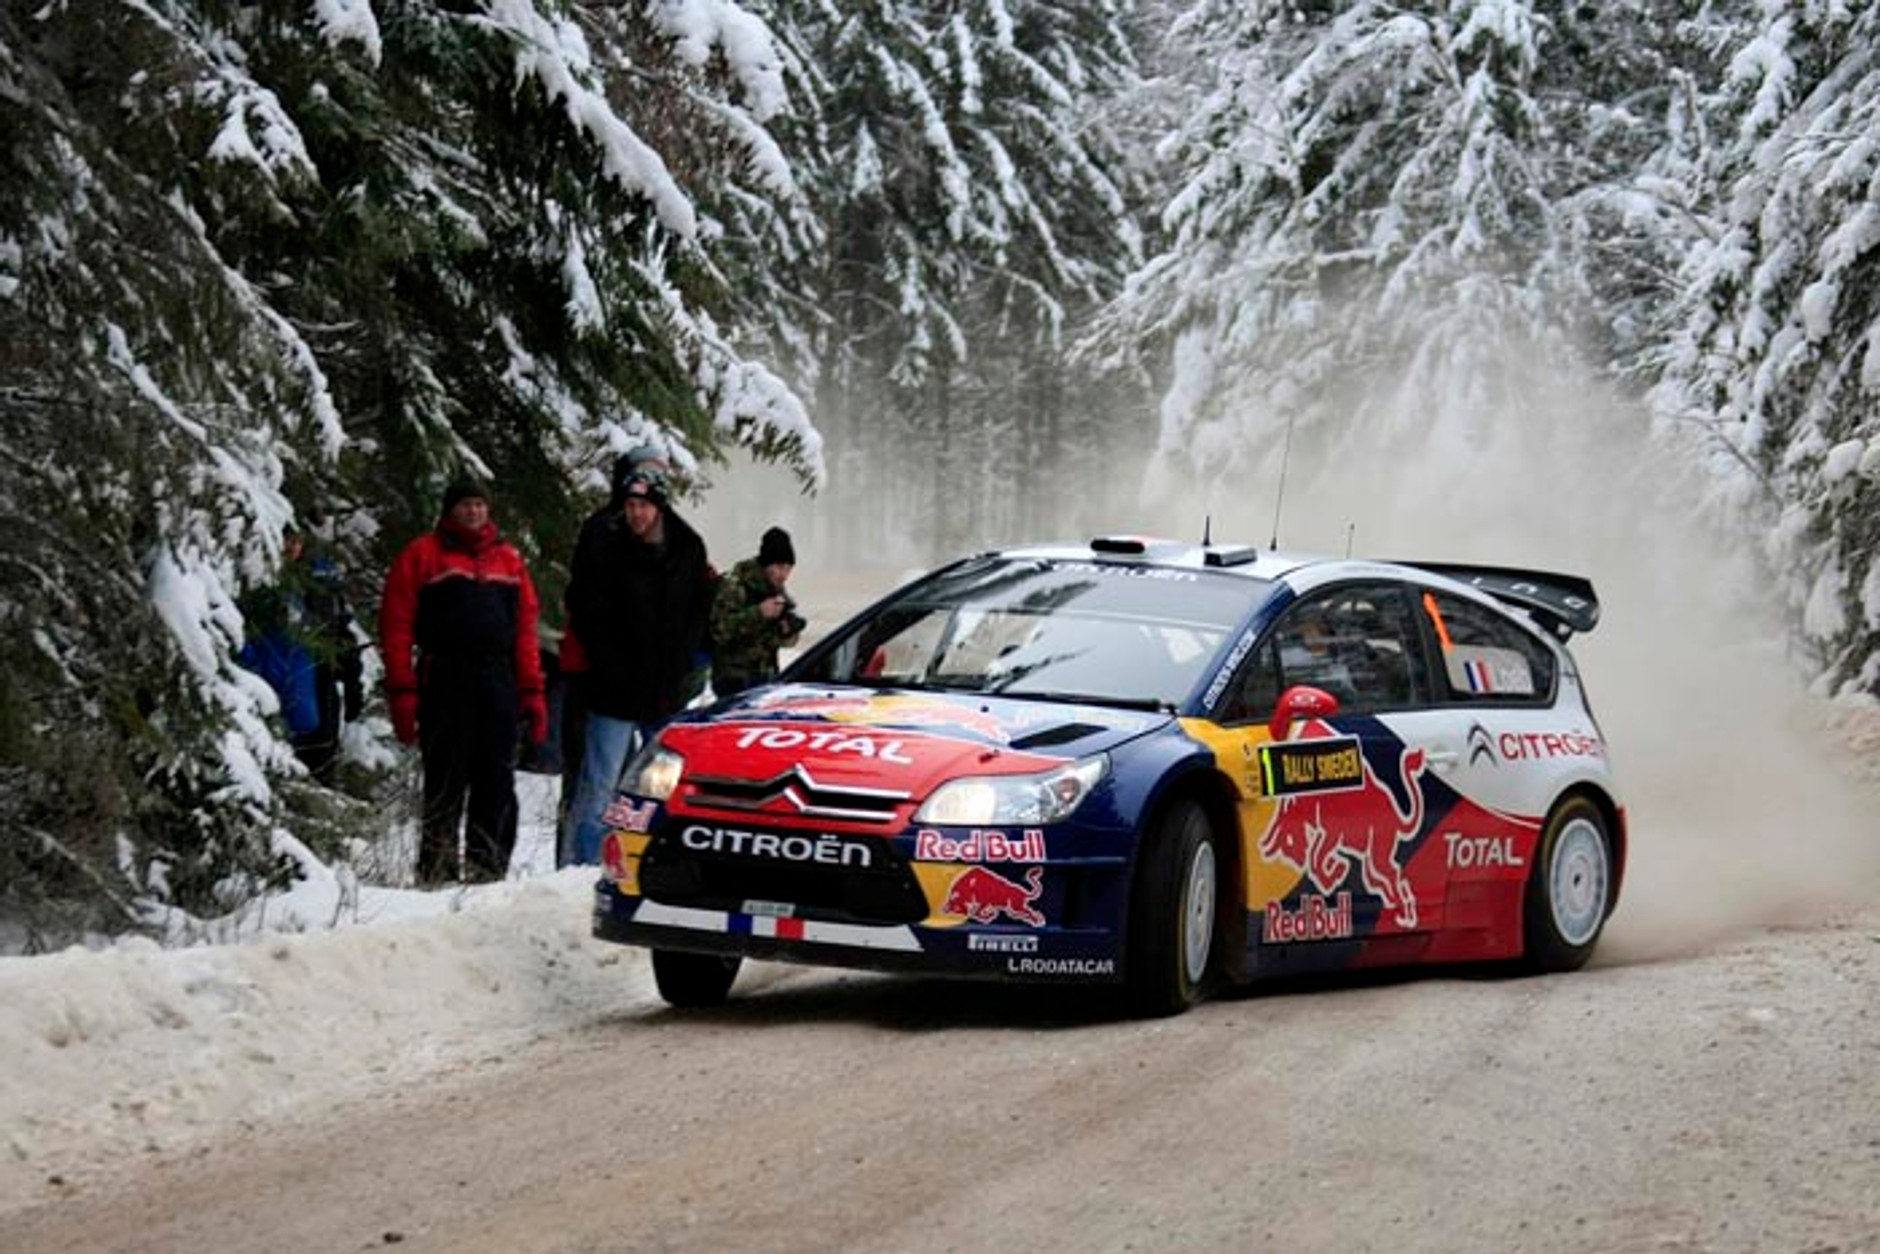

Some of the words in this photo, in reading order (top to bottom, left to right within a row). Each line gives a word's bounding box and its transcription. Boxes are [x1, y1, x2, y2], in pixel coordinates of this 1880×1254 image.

[736, 727, 913, 764] TOTAL
[1499, 729, 1608, 761] CITROË
[1283, 752, 1316, 786] RALLY
[1316, 746, 1362, 780] SWEDEN
[682, 825, 872, 867] CITROËN
[916, 829, 981, 860] Red
[984, 829, 1046, 862] Bull
[1443, 832, 1525, 870] TOTAL
[1263, 894, 1309, 942] Red
[1310, 891, 1352, 939] Bull
